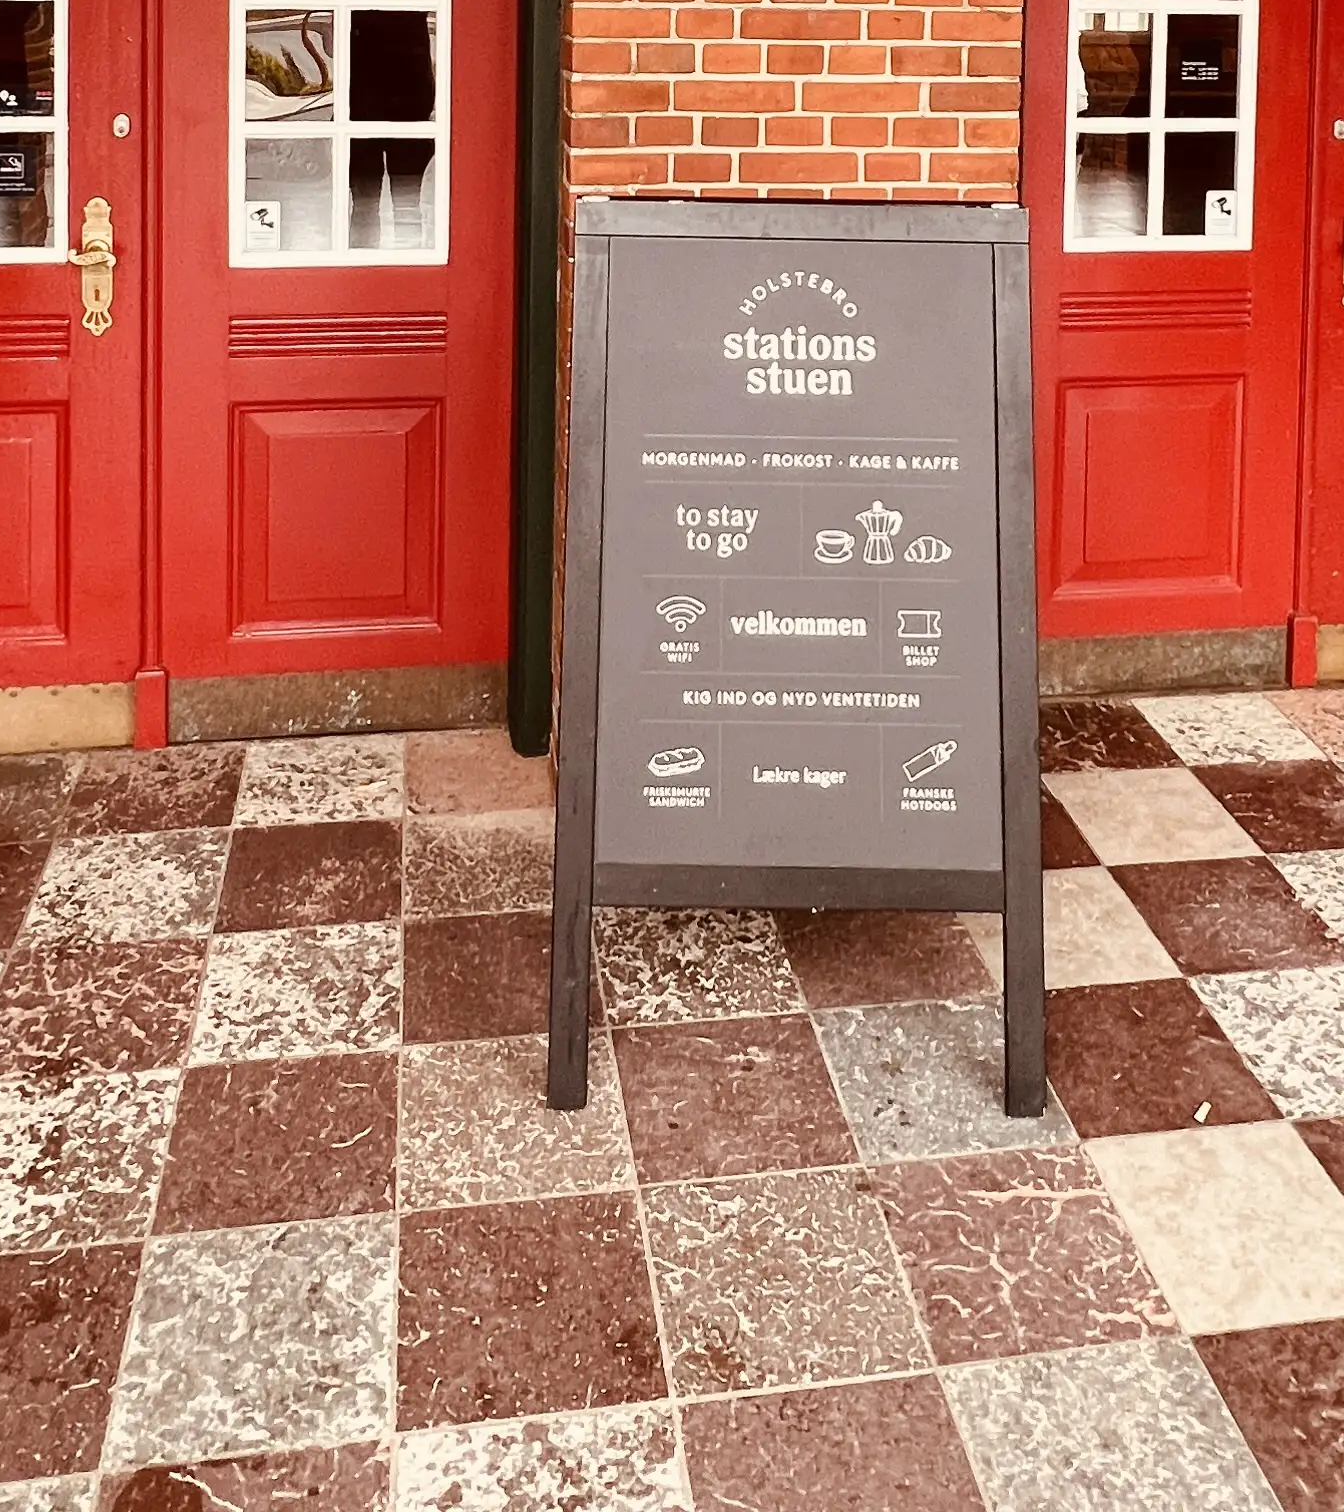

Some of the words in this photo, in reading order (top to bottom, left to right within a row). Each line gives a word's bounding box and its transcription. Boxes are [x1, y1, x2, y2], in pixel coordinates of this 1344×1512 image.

[738, 271, 858, 318] HOLSTEBRO
[722, 325, 877, 363] stations
[745, 361, 853, 396] stuen
[641, 451, 746, 467] MORGENMAD
[762, 453, 833, 469] FROKOST
[849, 454, 891, 469] KAGE
[911, 455, 960, 471] KAFFE
[676, 503, 701, 527] to
[706, 504, 759, 534] stay
[685, 529, 712, 551] to
[716, 532, 749, 559] go
[730, 610, 868, 637] velkommen
[659, 641, 700, 653] GRATIS
[902, 645, 940, 656] BILLET
[667, 652, 693, 664] WIFI
[905, 656, 938, 667] SHOP
[682, 690, 712, 705] KIG
[717, 690, 747, 706] IND
[751, 691, 777, 706] OG
[782, 691, 818, 707] NYD
[821, 692, 920, 709] VENTETIDEN
[752, 765, 800, 784] Lækre
[803, 766, 847, 789] kager
[648, 797, 706, 808] SANDWICH
[902, 787, 955, 799] FRANSKE
[900, 800, 957, 811] HOTDOGS
